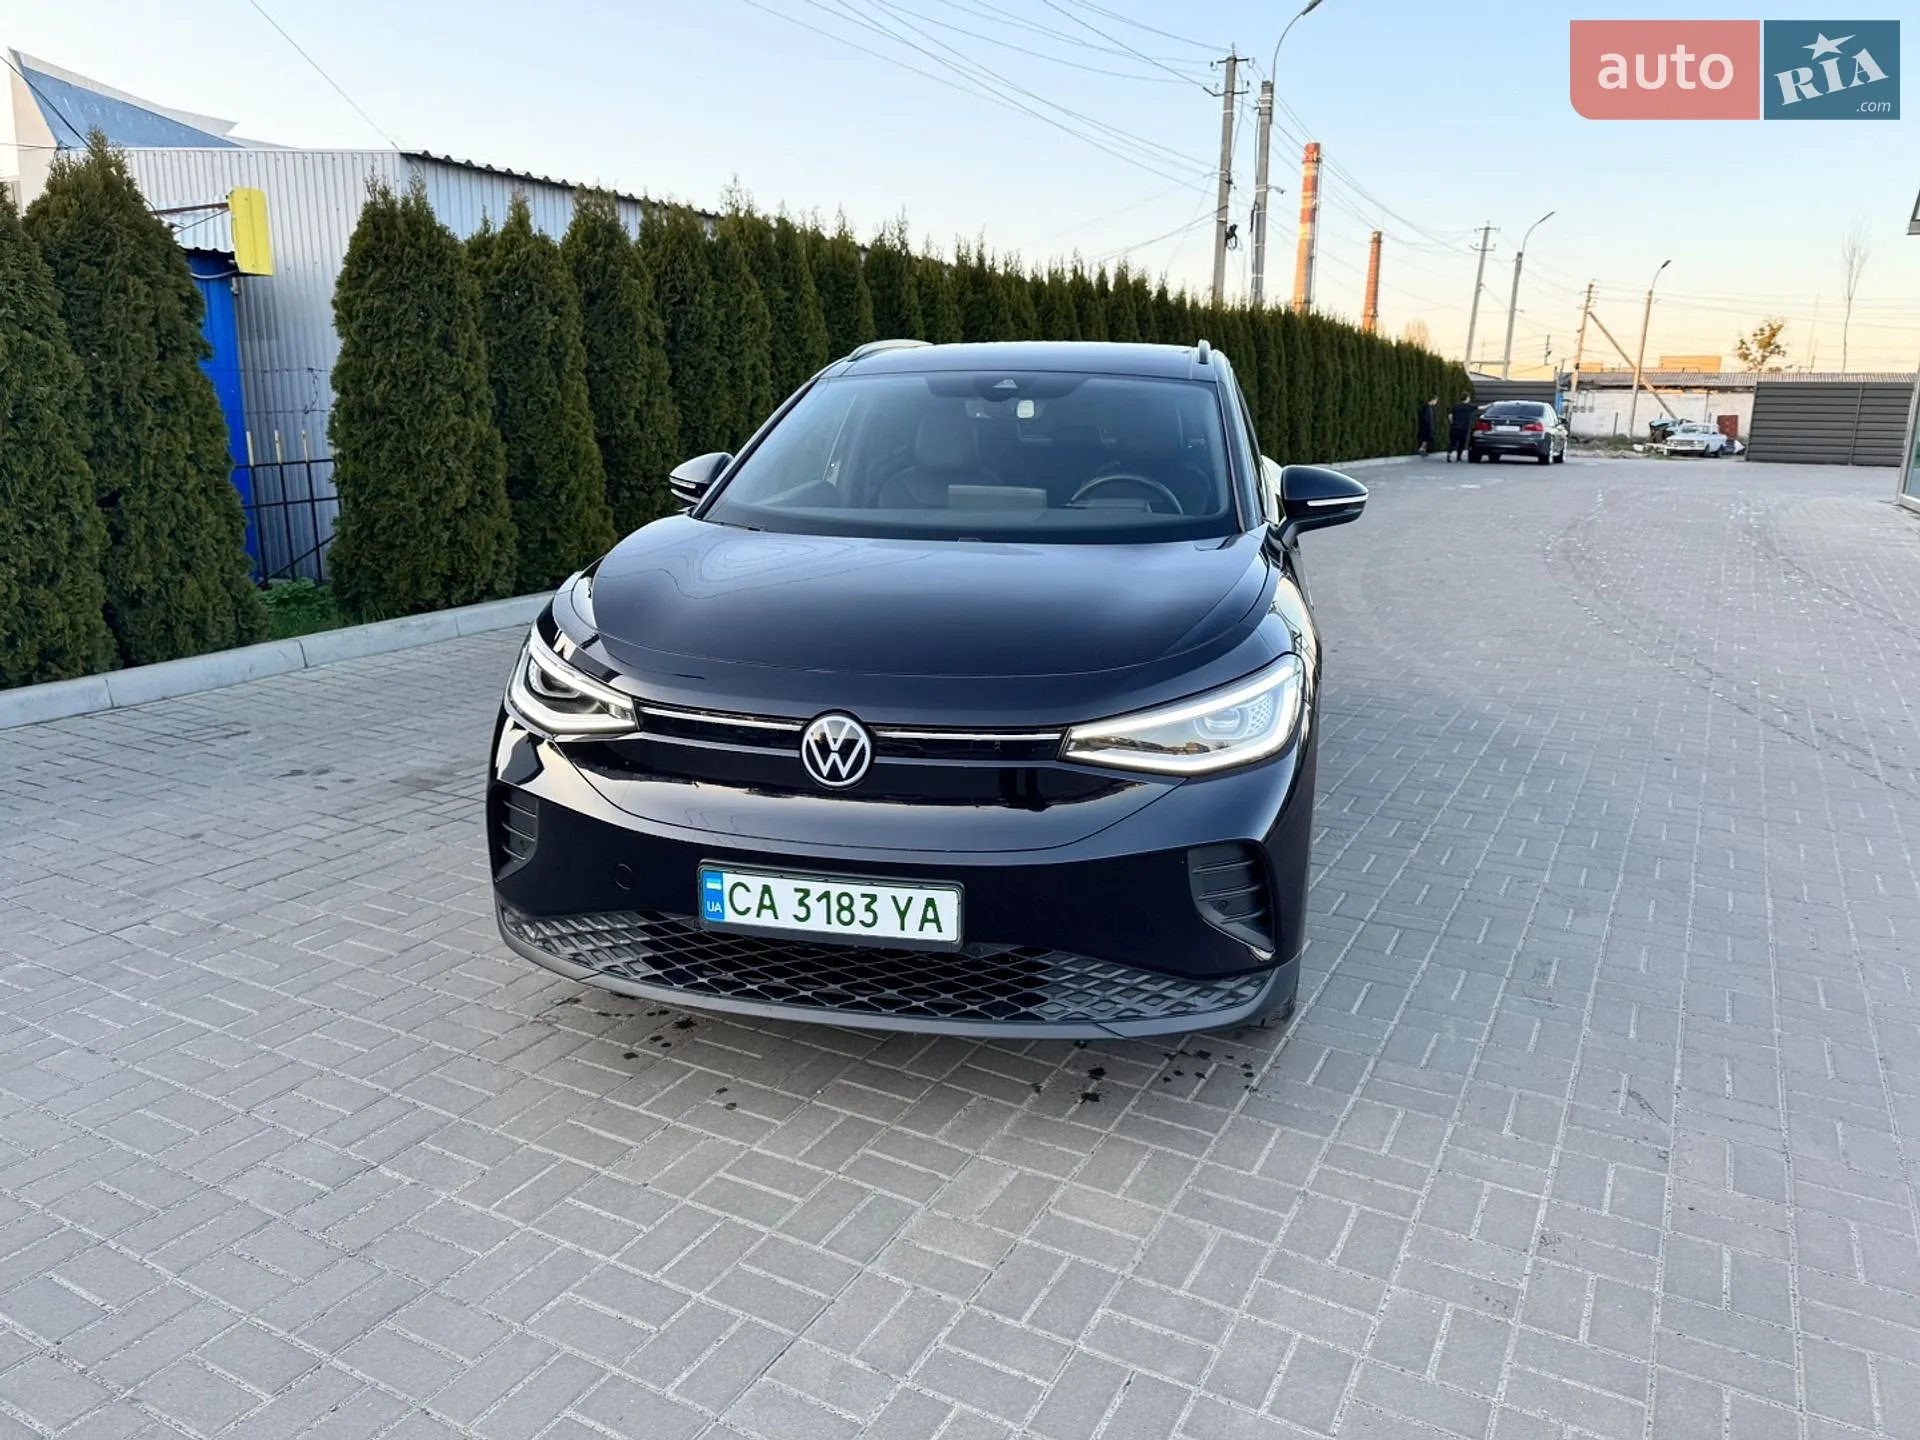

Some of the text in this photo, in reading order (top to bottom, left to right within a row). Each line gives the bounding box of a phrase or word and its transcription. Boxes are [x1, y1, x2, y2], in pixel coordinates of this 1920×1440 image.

[706, 901, 723, 913] UA
[728, 881, 943, 933] CA 3183 YA
